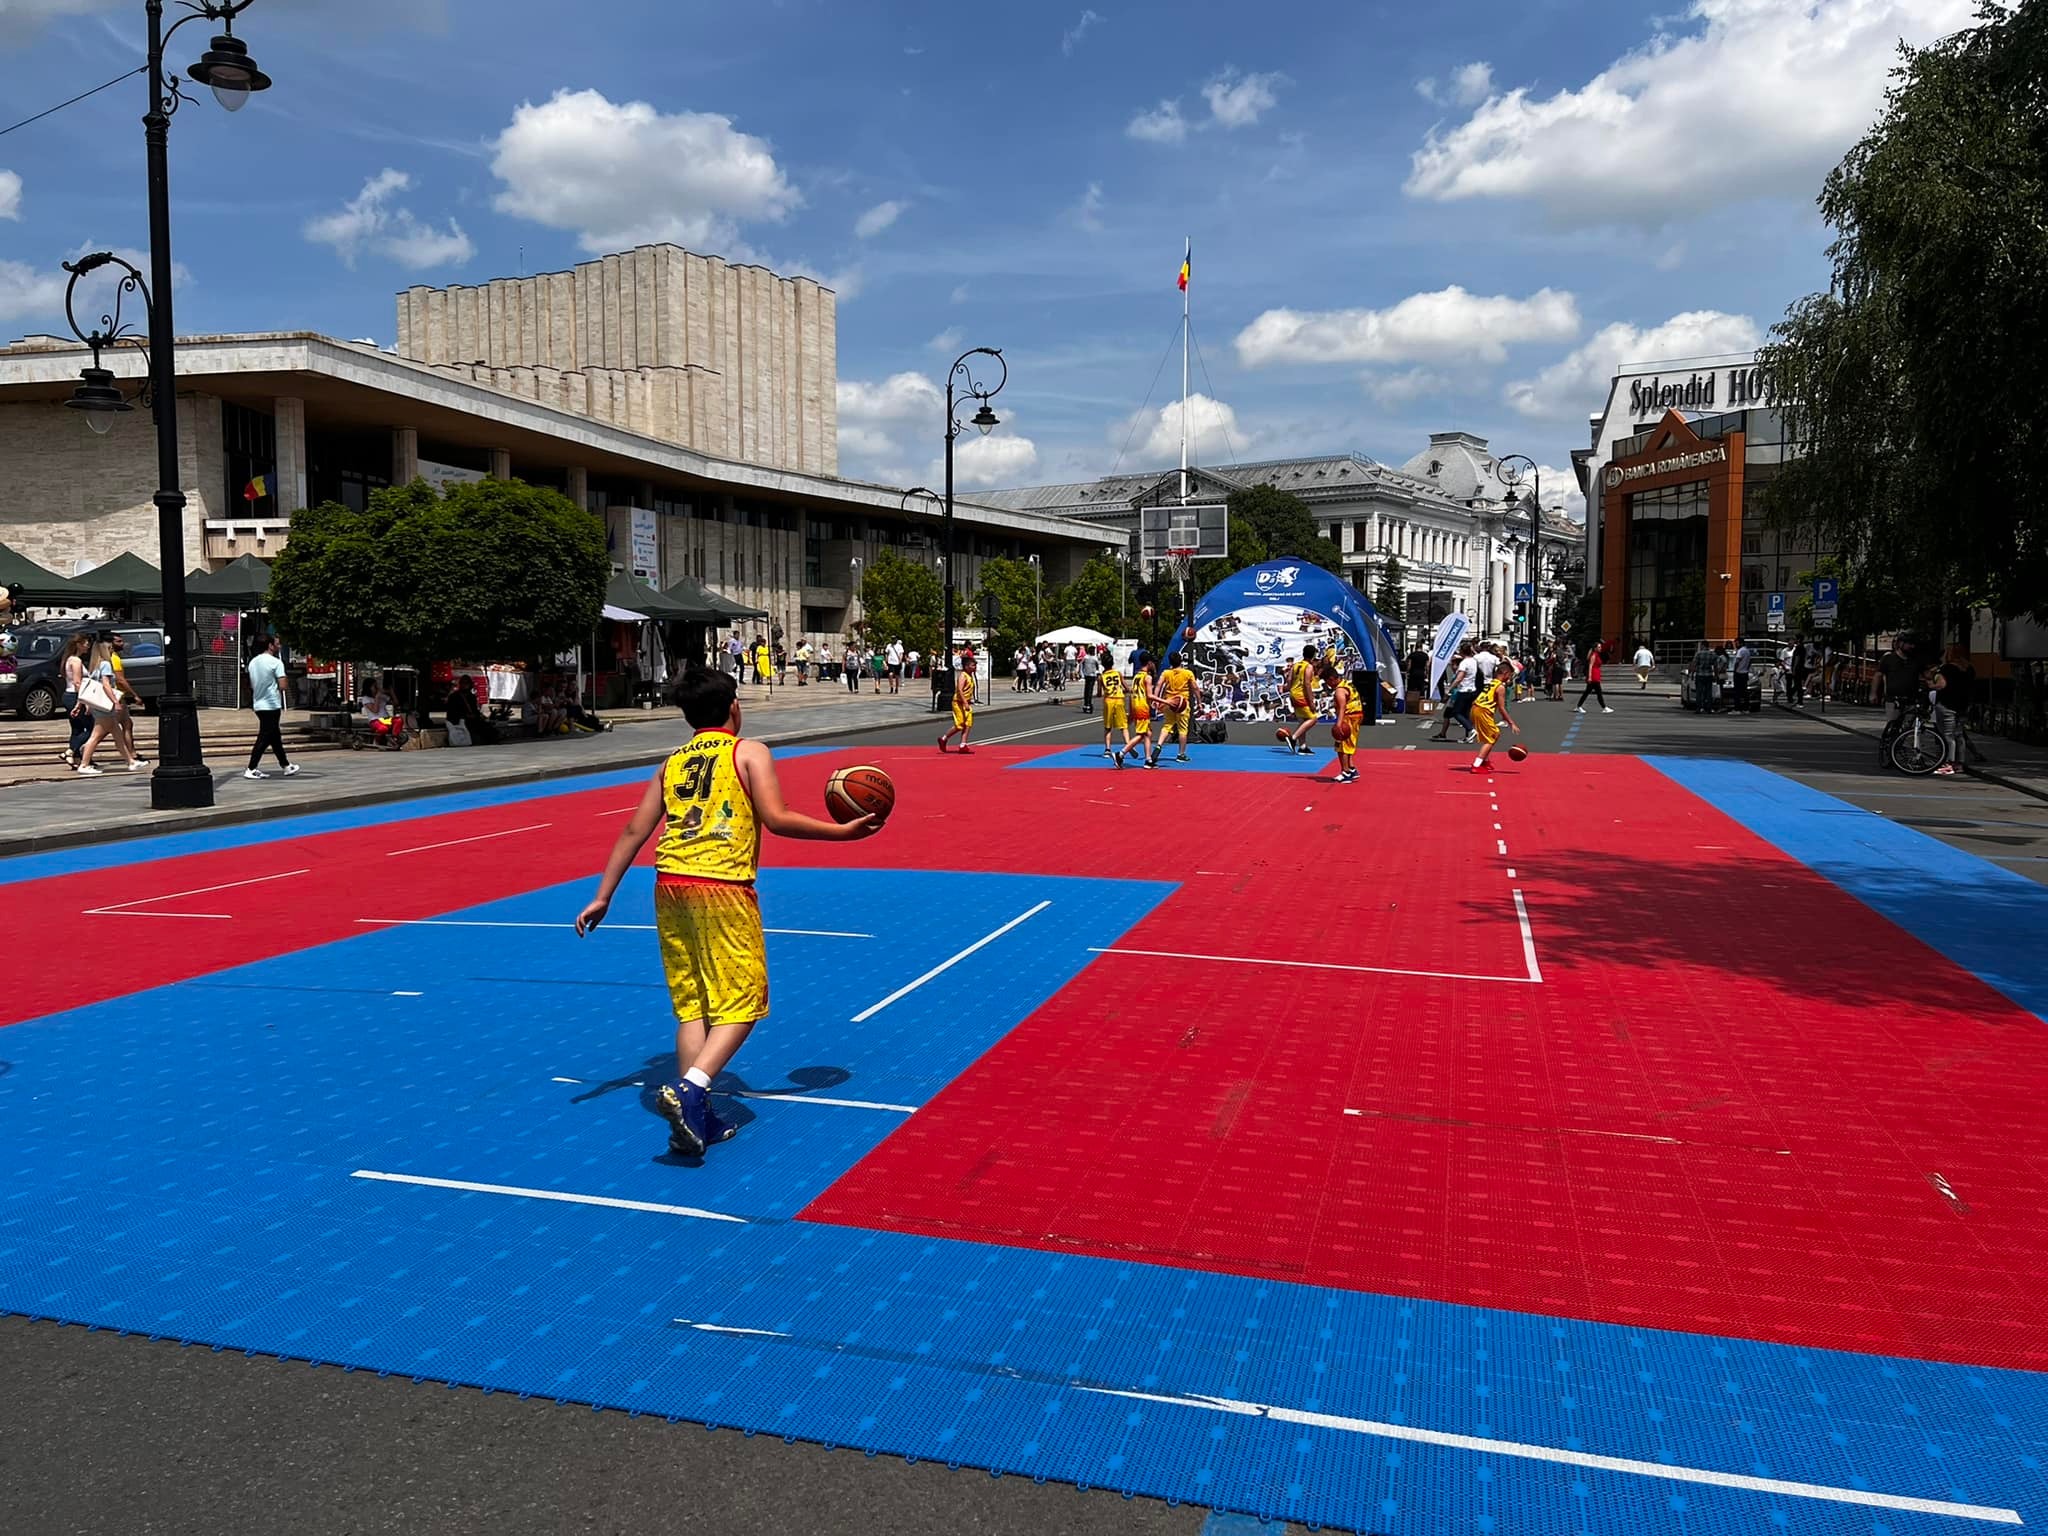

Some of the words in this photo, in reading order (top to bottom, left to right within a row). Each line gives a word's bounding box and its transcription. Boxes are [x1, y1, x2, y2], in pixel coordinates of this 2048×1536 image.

[1631, 372, 1715, 416] Splendid
[1625, 461, 1656, 480] BANCA
[1818, 582, 1832, 599] P
[1772, 595, 1781, 608] P
[1105, 676, 1119, 686] 25
[673, 753, 720, 801] 31
